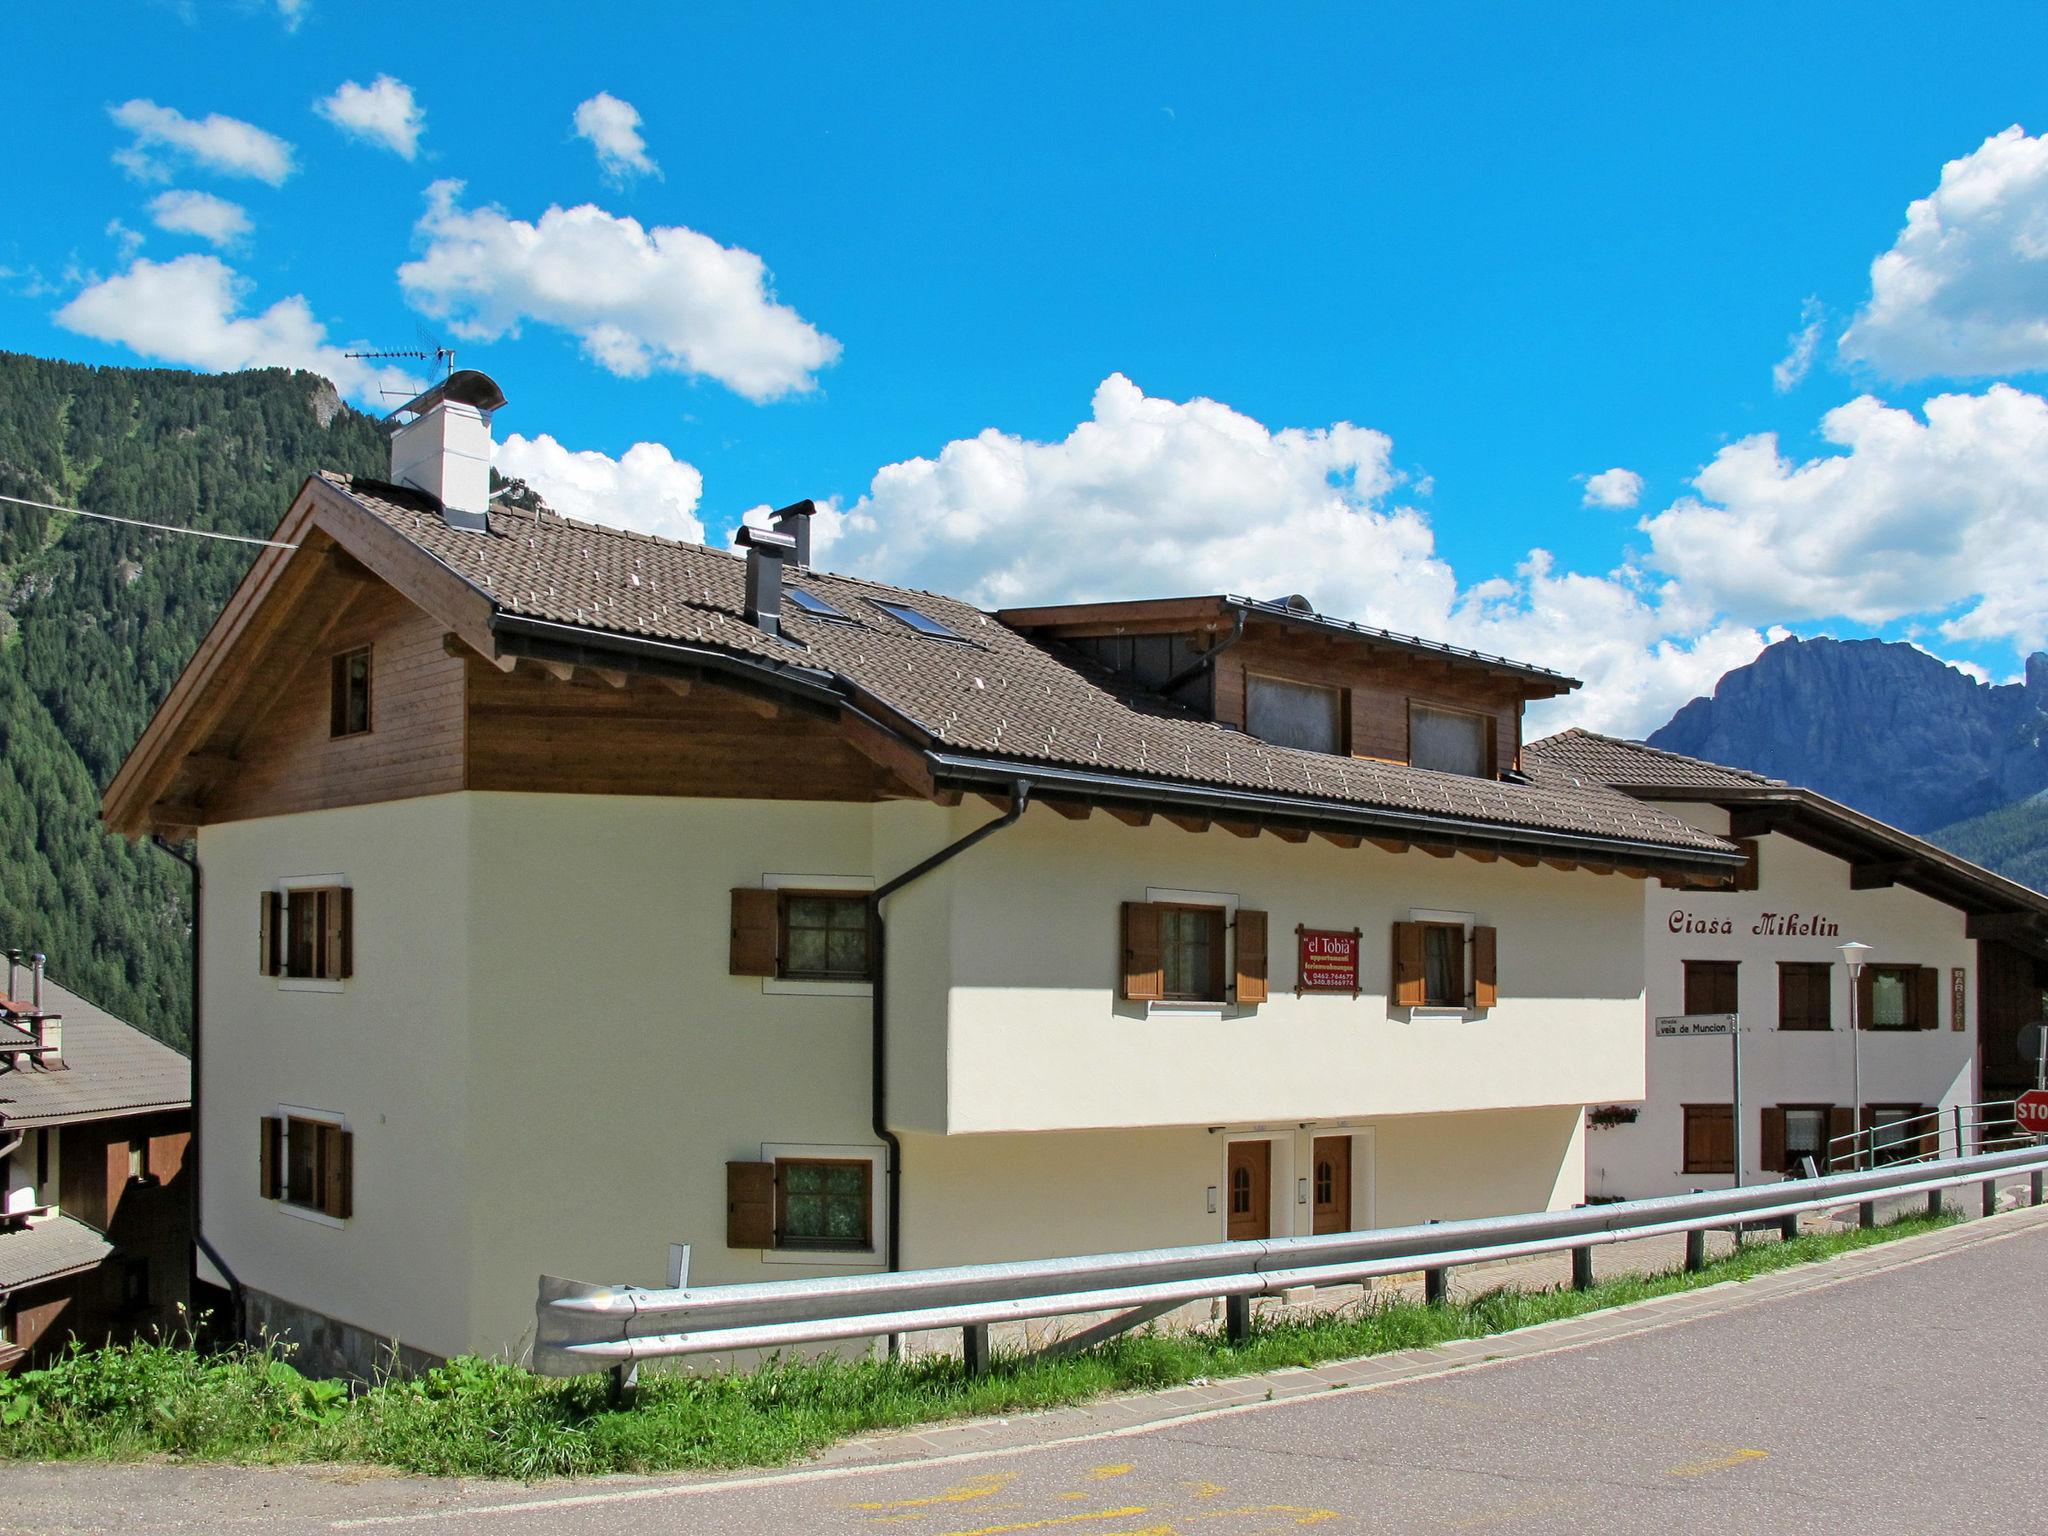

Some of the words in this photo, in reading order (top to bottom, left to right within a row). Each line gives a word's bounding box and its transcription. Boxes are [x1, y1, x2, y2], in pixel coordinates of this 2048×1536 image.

[1751, 912, 1839, 936] Mikelin
[1680, 1024, 1689, 1034] de
[1693, 1023, 1726, 1033] Muncion
